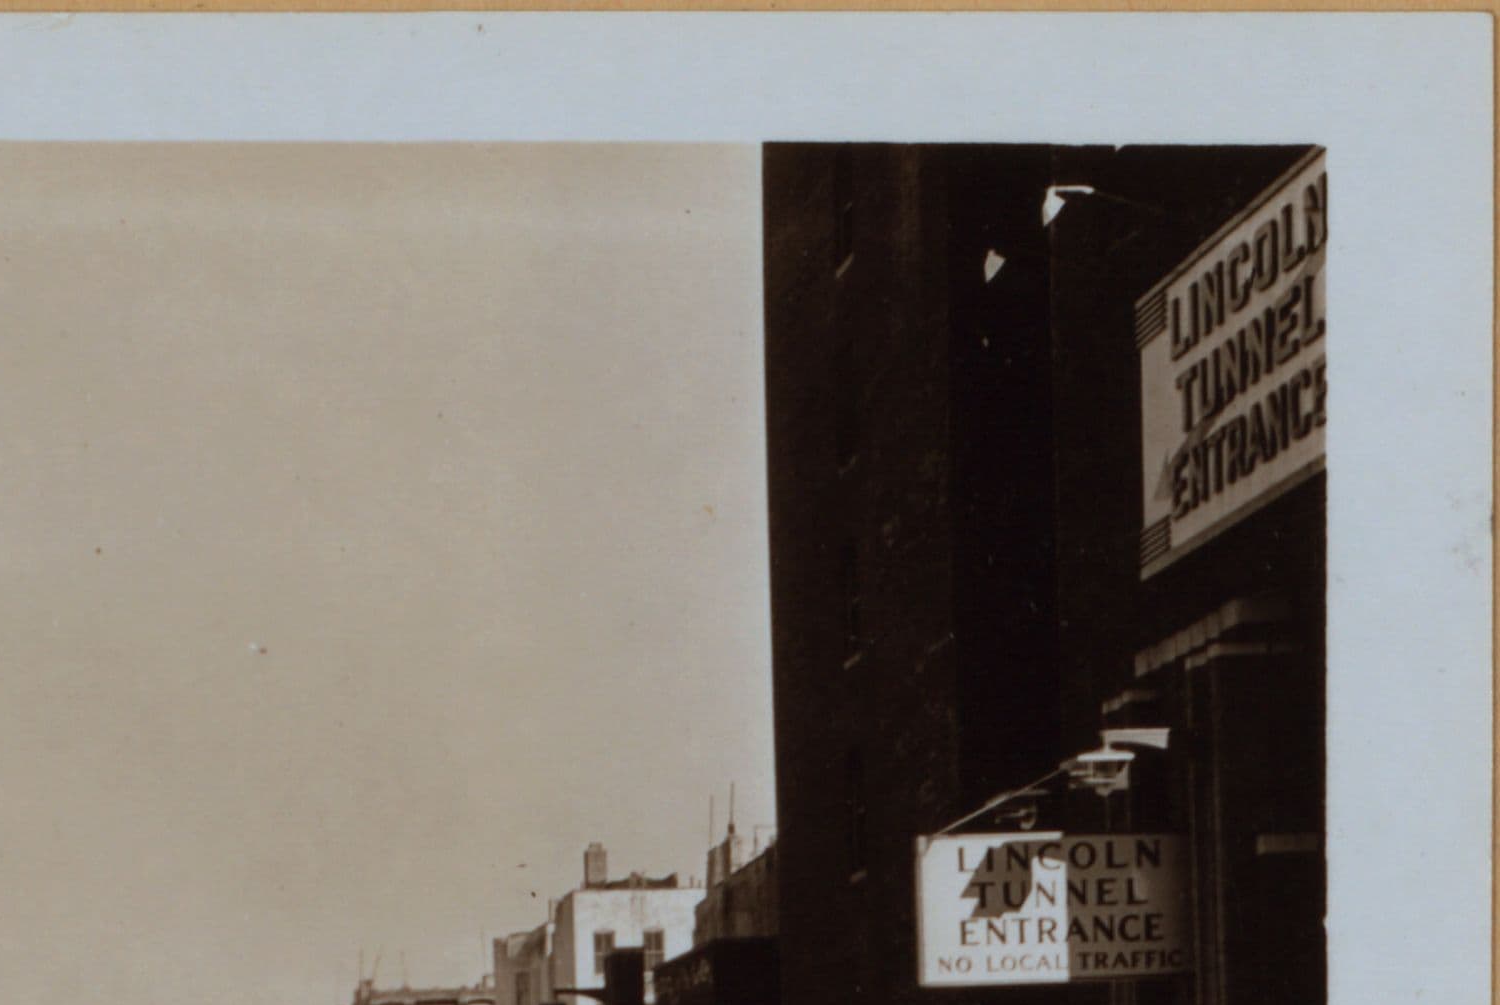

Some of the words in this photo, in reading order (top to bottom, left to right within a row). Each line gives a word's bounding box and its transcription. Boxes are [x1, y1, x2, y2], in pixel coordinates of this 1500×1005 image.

[1170, 171, 1327, 362] LINCOLN
[1175, 274, 1325, 433] TUNNEL
[1171, 359, 1327, 521] ENTRANCE
[957, 839, 1161, 873] LINCOLN
[971, 878, 1149, 909] TUNNEL
[960, 912, 1164, 946] ENTRANCE
[936, 956, 973, 974] NO
[985, 953, 1069, 973] LOCAL
[1079, 951, 1185, 970] TRAFFIC
